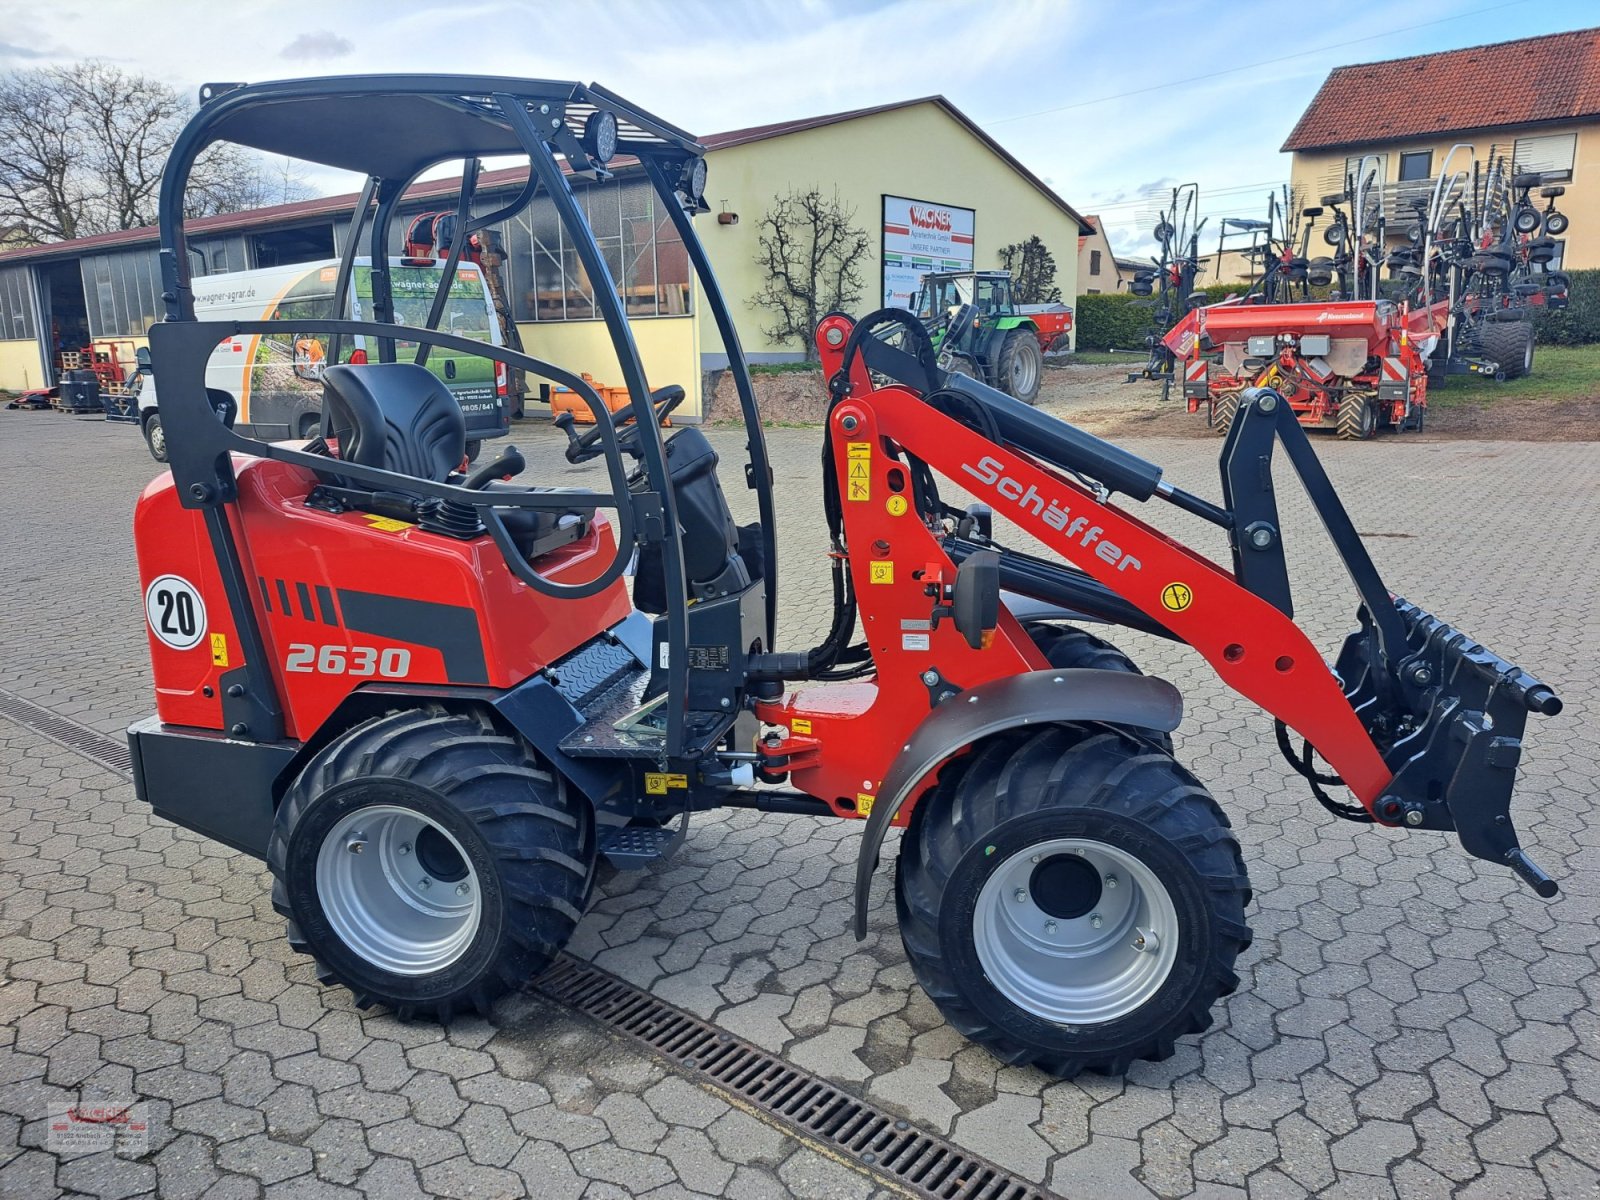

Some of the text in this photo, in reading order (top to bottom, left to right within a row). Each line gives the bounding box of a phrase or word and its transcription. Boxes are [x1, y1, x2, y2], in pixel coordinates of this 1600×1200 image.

[910, 205, 952, 231] WAGNER
[911, 243, 951, 255] UNSERE PARTNER
[195, 285, 256, 305] w.wagner-agrar.de
[1327, 312, 1364, 320] Kverneland
[961, 456, 1142, 572] Schäffer
[157, 589, 196, 637] 20
[285, 643, 411, 678] 2630
